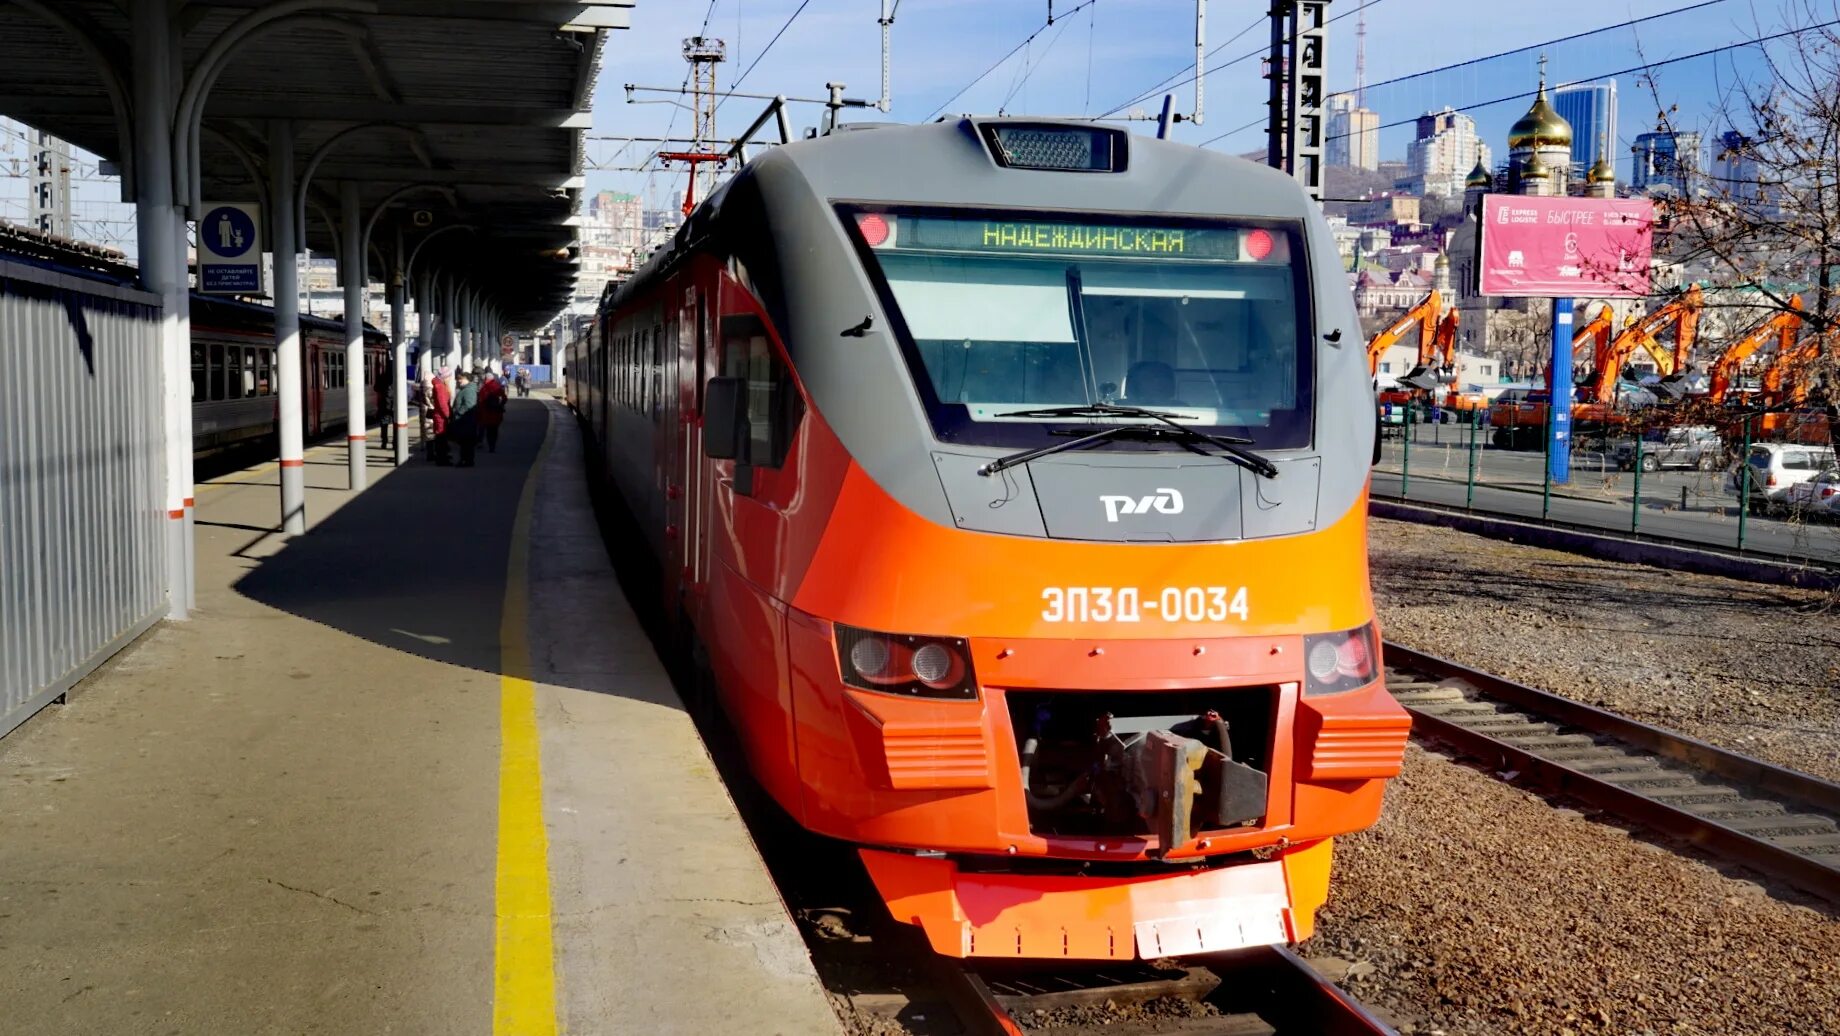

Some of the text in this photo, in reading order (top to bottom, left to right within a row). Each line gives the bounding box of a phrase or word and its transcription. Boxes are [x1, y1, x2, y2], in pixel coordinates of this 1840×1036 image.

[1511, 208, 1538, 216] EXPRESS
[1547, 209, 1594, 225] БЫСТРЕЕ
[983, 223, 1185, 252] НАДЕЖДИНСКАЯ
[1565, 232, 1578, 254] 6
[1100, 487, 1184, 522] РЖД
[1041, 586, 1249, 623] ЭП3Д-0034
